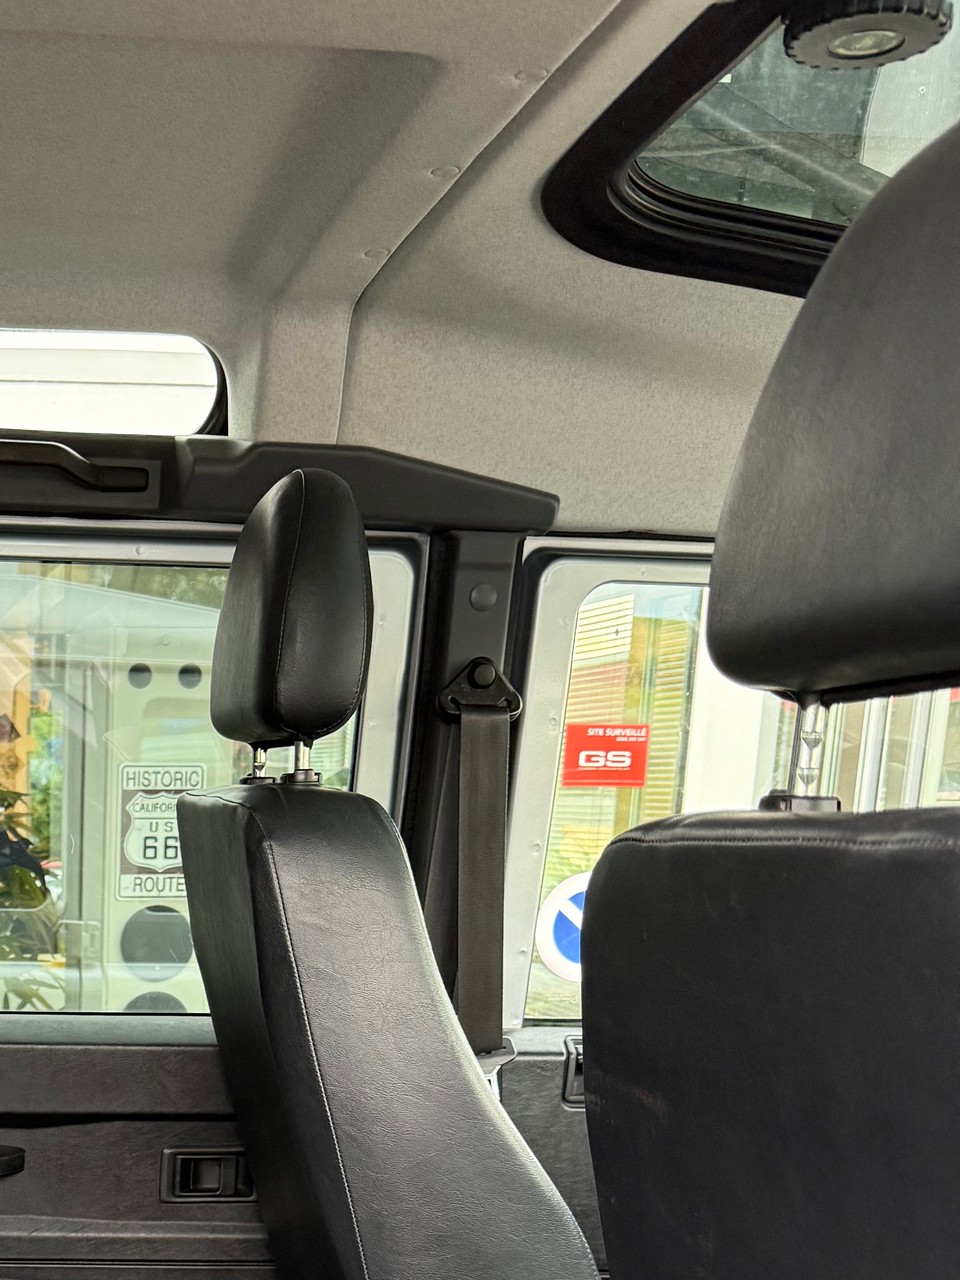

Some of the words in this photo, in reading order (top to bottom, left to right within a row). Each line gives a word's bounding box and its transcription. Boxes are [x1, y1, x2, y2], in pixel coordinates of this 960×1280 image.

[587, 728, 604, 736] SITE
[578, 750, 632, 767] GS
[126, 771, 200, 788] HISTORIC
[133, 803, 176, 813] CALIFOR
[143, 836, 178, 860] 66
[133, 876, 185, 893] ROUTE
